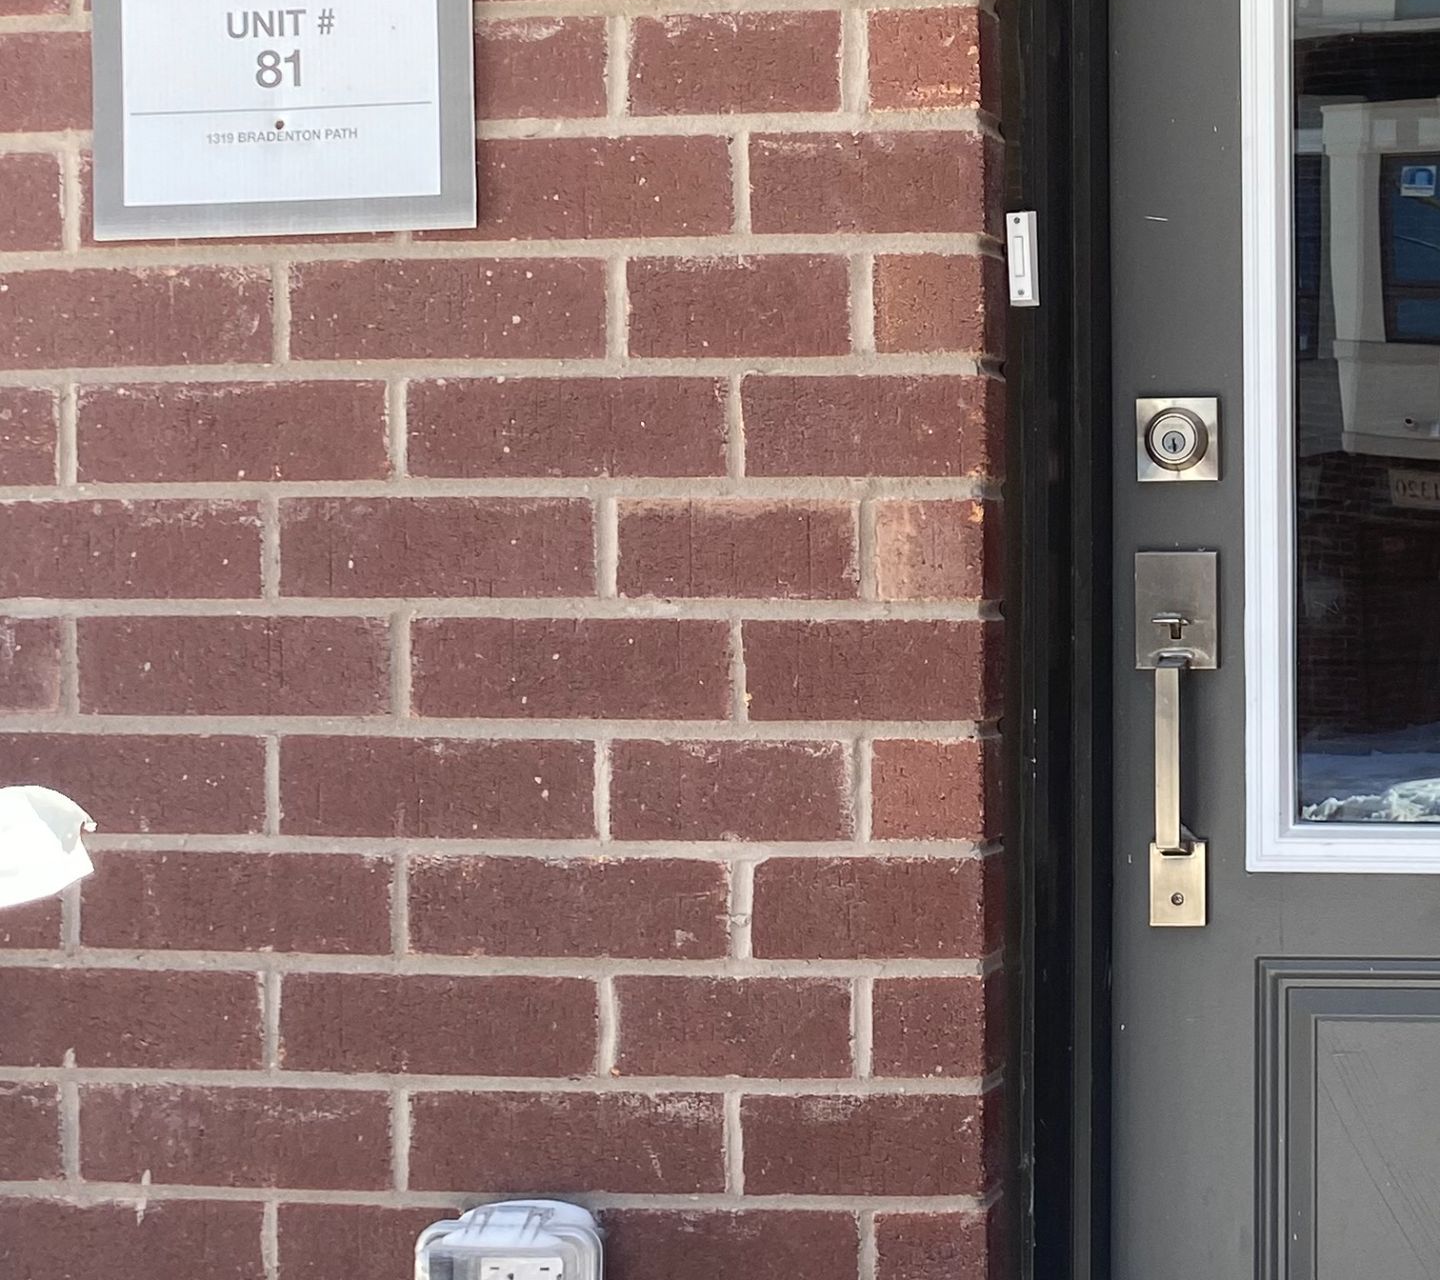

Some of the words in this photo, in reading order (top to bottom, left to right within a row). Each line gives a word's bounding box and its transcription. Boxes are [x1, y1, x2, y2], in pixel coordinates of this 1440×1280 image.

[226, 9, 306, 39] UNIT
[316, 8, 336, 36] #
[255, 48, 302, 88] 81
[206, 132, 235, 145] 1319
[238, 129, 321, 144] BRADENTON
[325, 128, 358, 140] PATH
